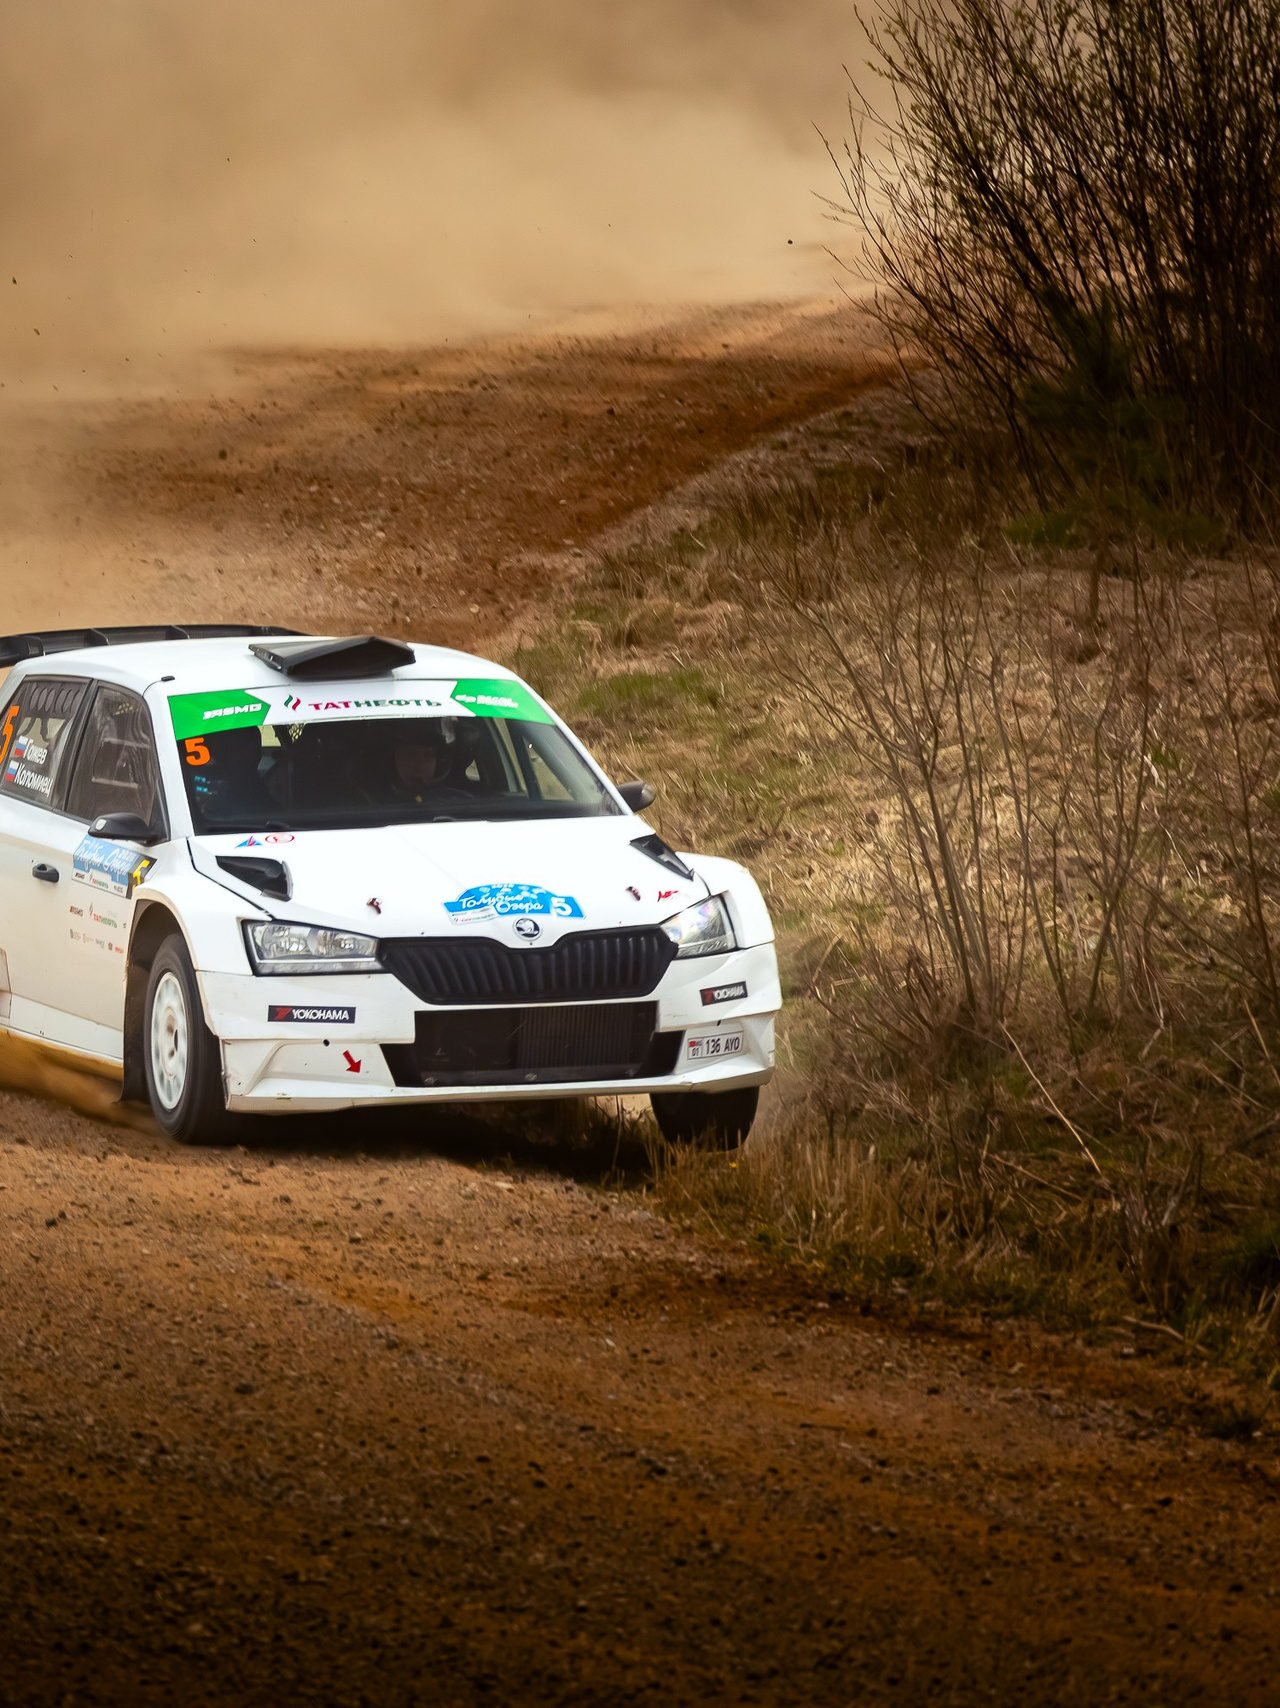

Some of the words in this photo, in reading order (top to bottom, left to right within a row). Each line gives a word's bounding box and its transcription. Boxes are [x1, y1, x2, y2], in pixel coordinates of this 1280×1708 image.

[308, 699, 443, 711] ТАТНЕФТЬ
[23, 738, 48, 765] Гожев
[184, 737, 211, 766] 5
[551, 897, 574, 915] 5
[291, 1008, 350, 1020] YOKOHAMA
[692, 1047, 699, 1056] 01
[706, 1037, 721, 1055] 136
